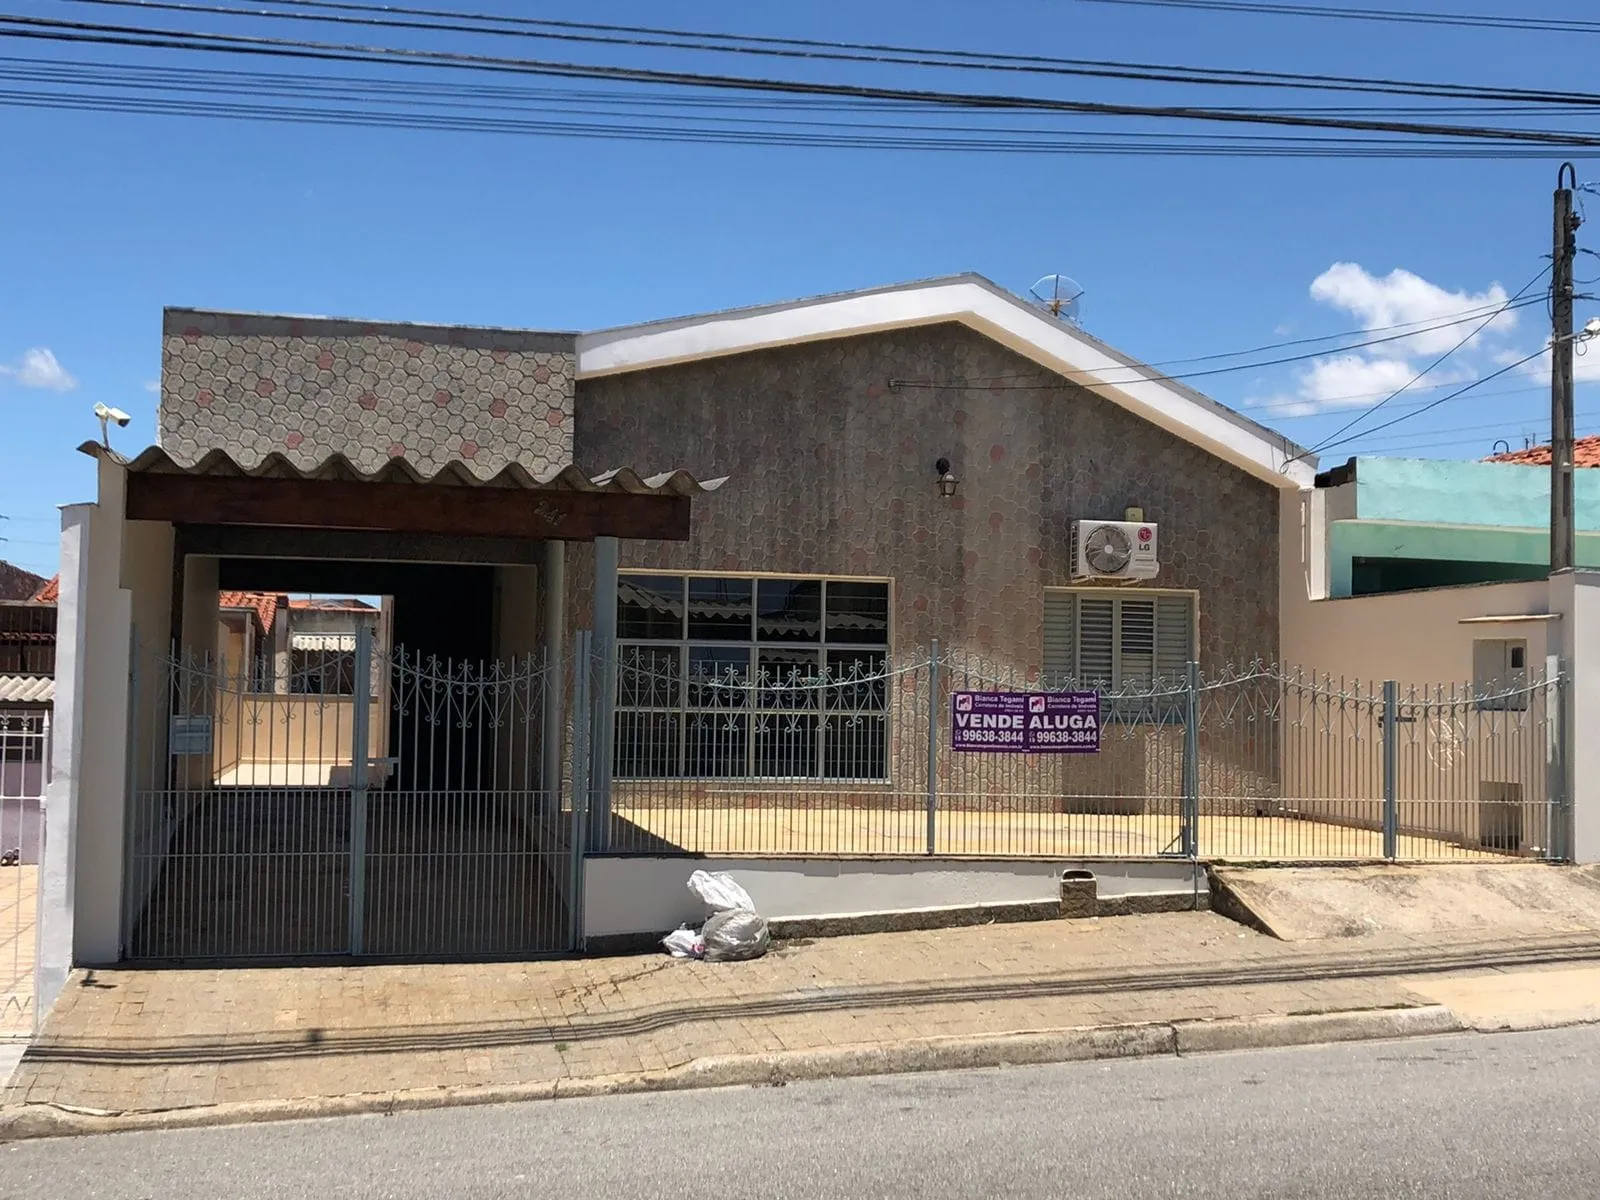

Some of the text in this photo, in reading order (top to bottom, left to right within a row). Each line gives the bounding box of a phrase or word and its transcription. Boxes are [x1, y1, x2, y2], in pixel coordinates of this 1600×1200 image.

[955, 714, 1025, 729] VENDE
[1029, 715, 1097, 729] ALUGA
[962, 729, 1024, 743] 99638-3844
[1036, 730, 1097, 743] 99638-3844
